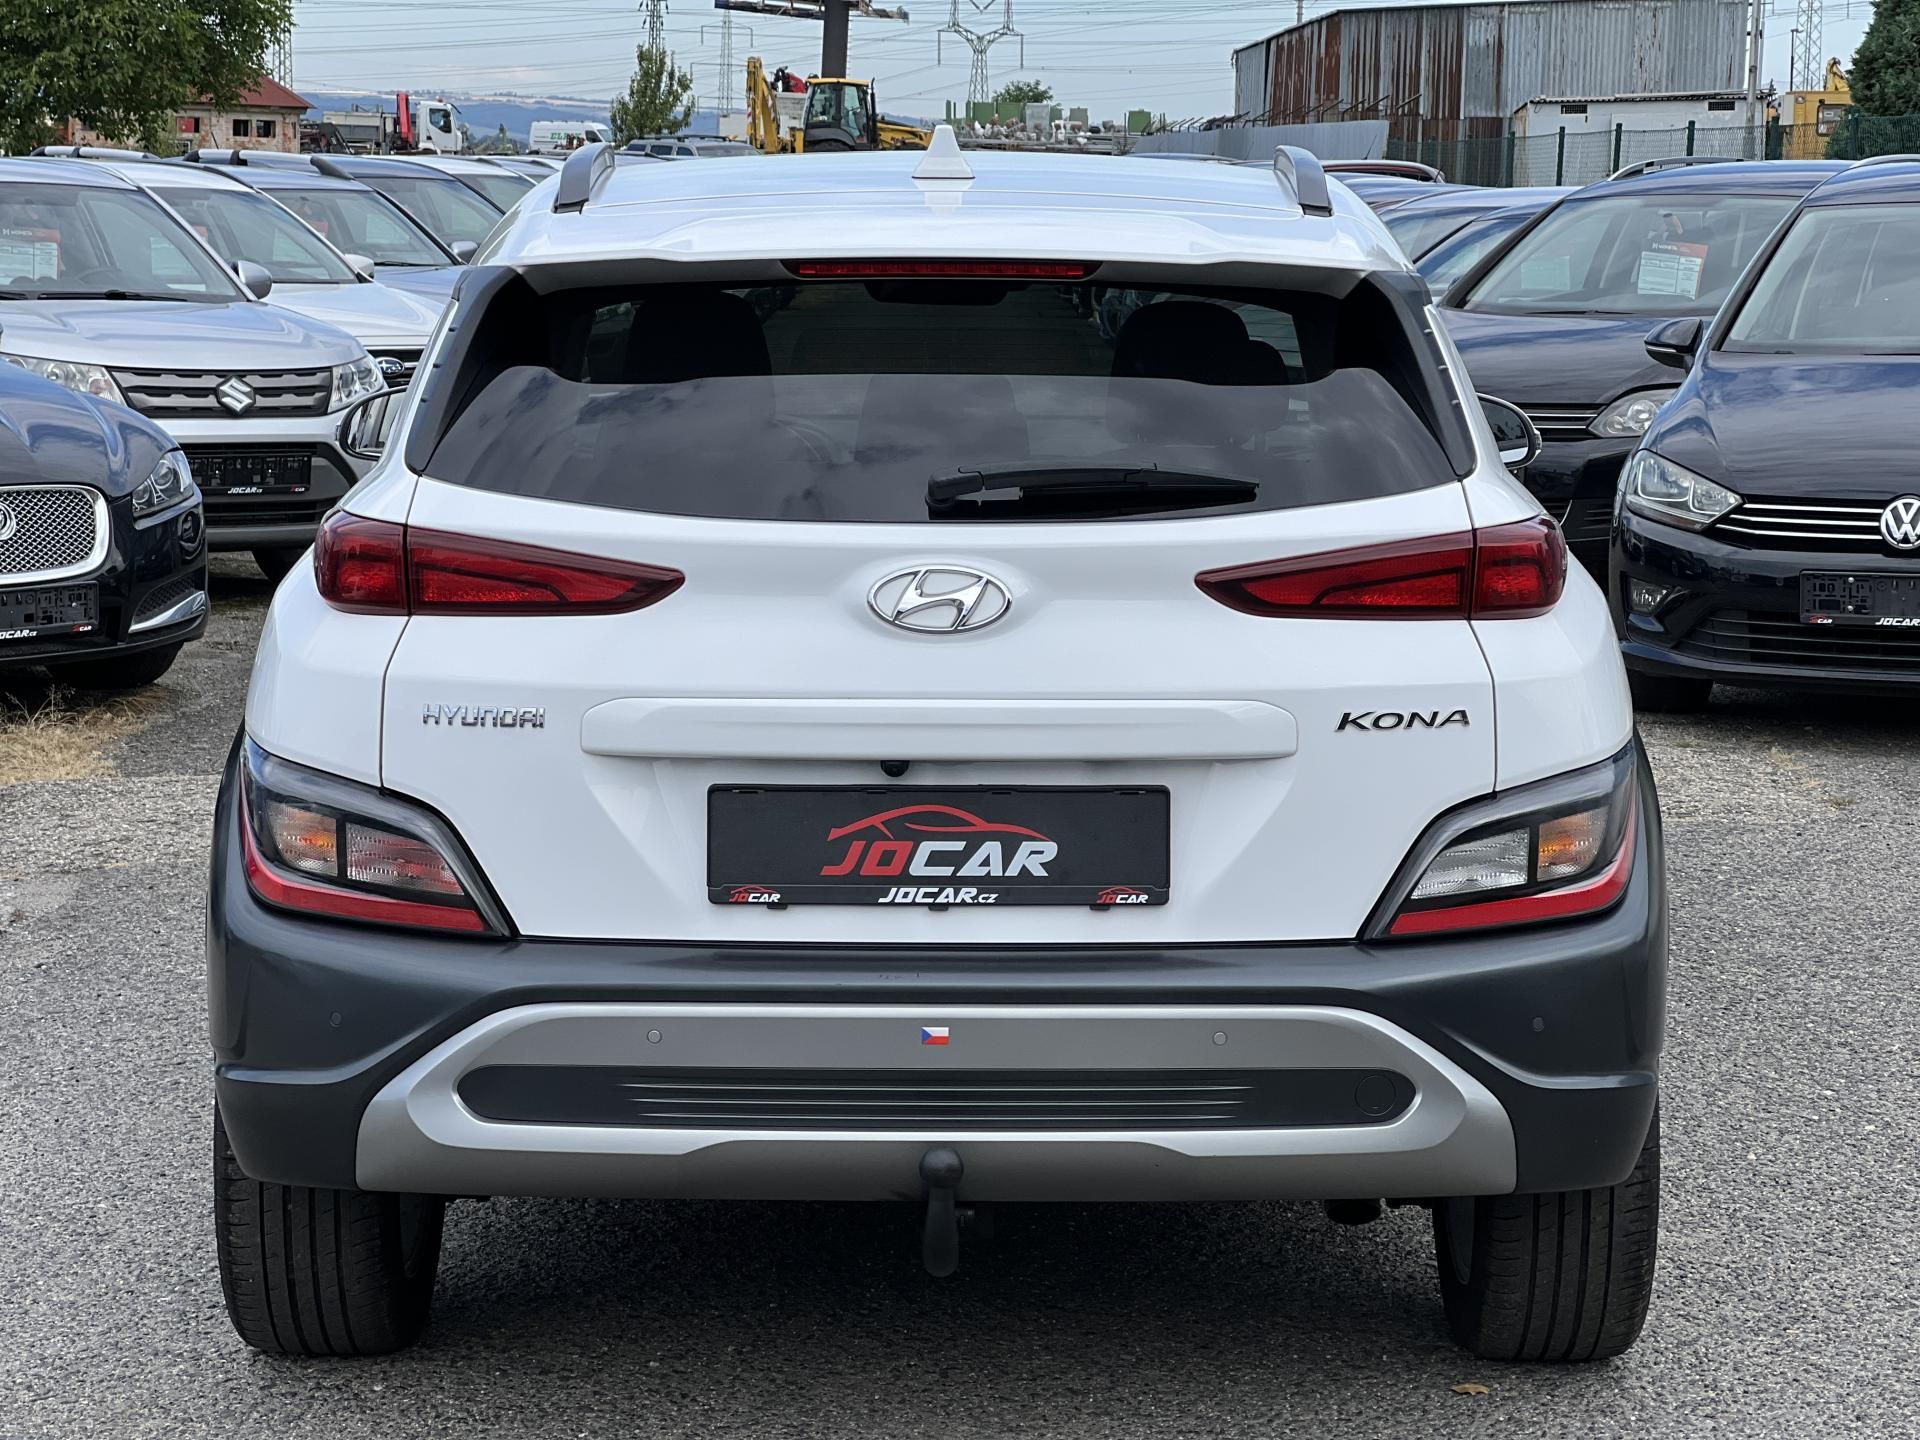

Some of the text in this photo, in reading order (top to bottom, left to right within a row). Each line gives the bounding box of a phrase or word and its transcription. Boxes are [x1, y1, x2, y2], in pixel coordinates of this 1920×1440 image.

[0, 629, 37, 639] OCAR.cz
[422, 703, 546, 728] HYUNDAI
[1334, 709, 1471, 732] KONA
[820, 840, 1058, 877] JOCAR
[729, 893, 781, 903] JOCAR
[877, 887, 999, 903] JOCAR.cz
[1097, 894, 1149, 904] JOCAR
